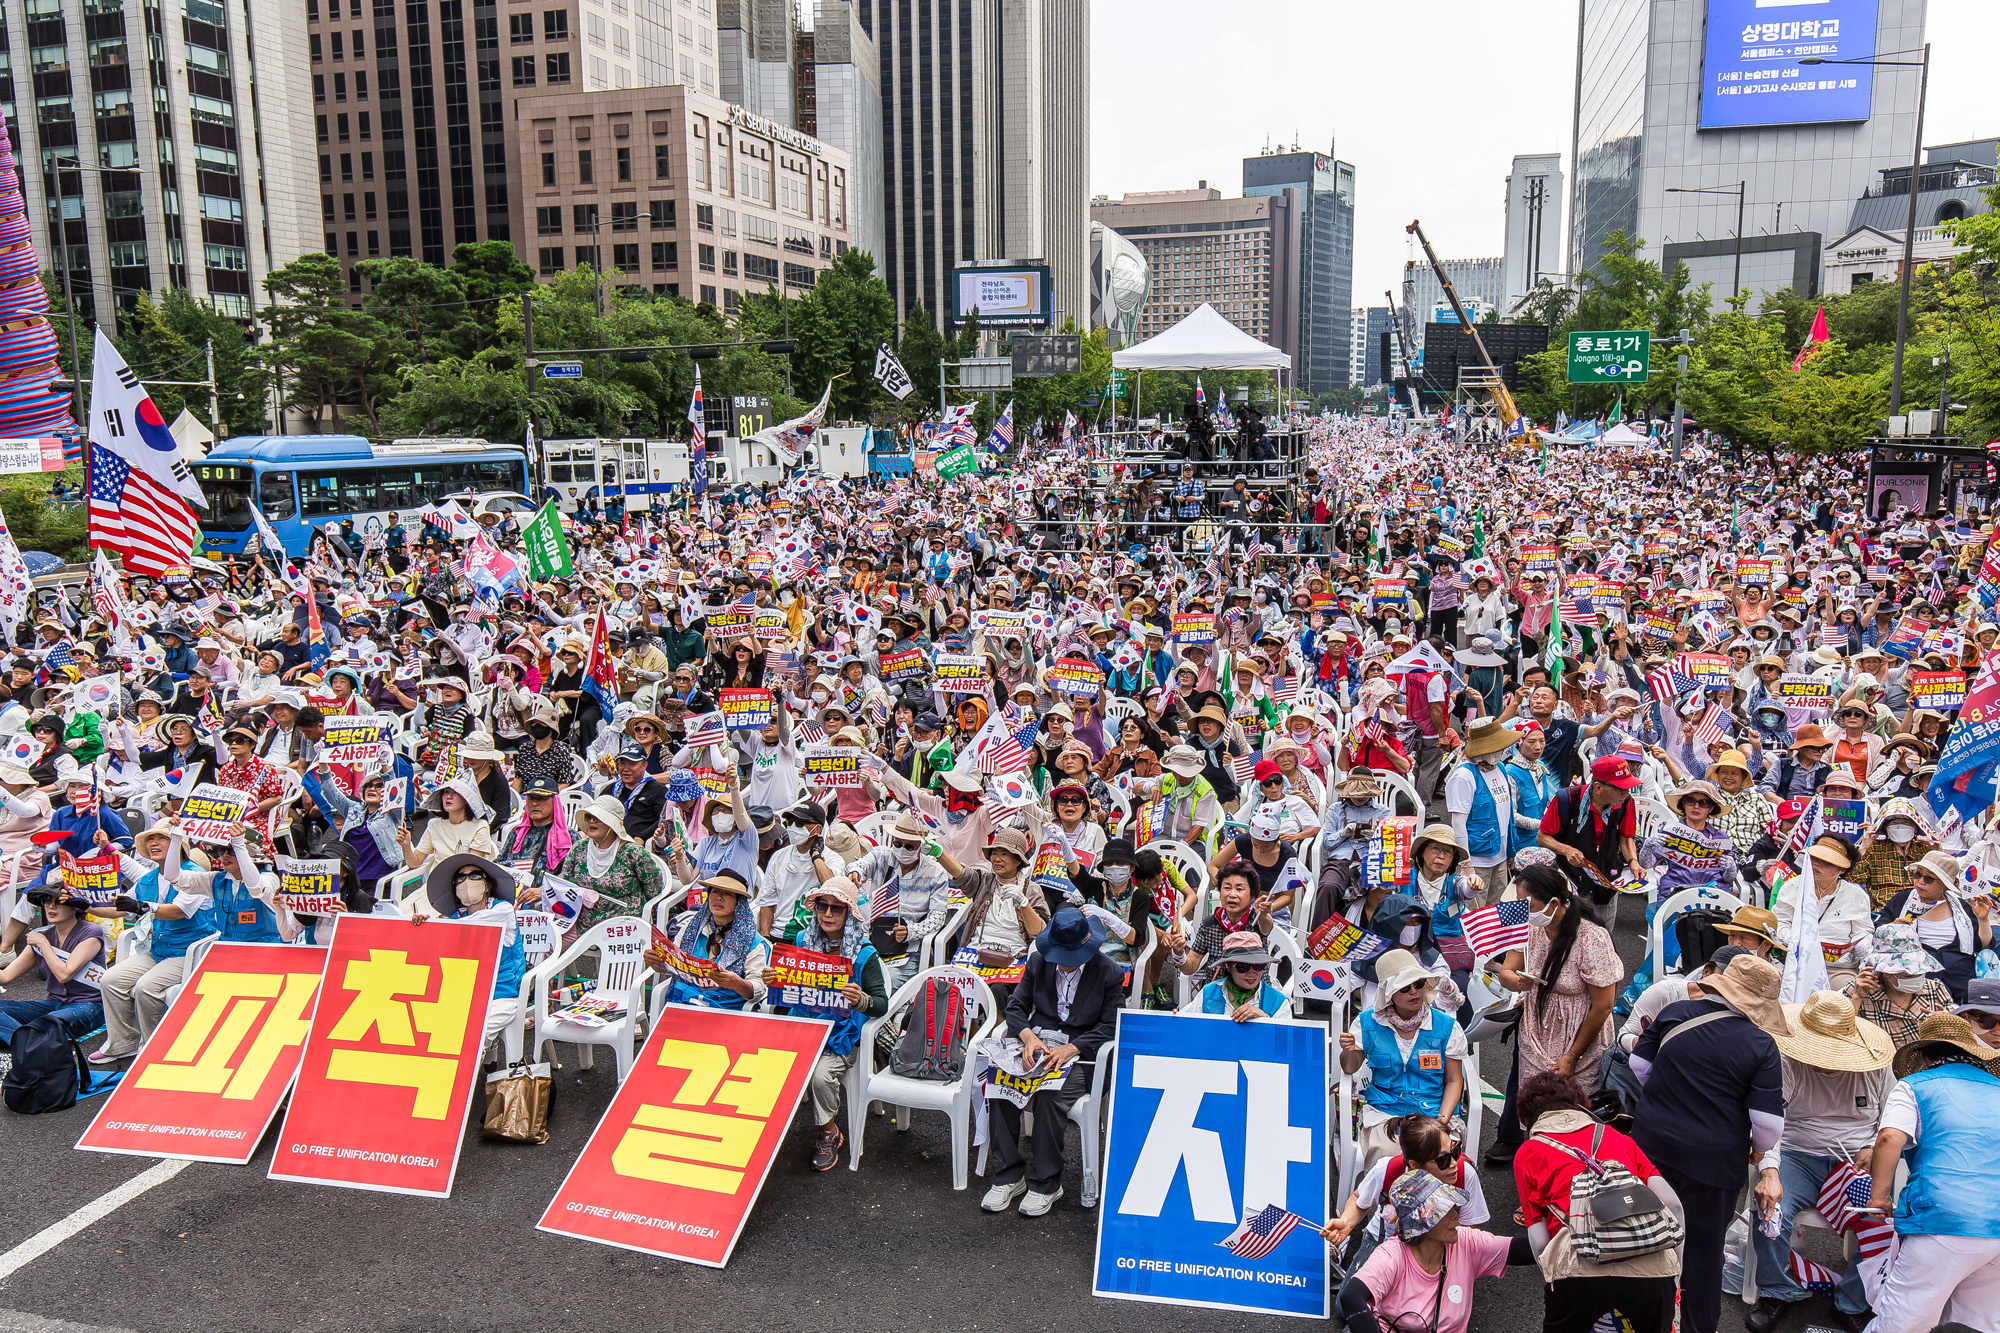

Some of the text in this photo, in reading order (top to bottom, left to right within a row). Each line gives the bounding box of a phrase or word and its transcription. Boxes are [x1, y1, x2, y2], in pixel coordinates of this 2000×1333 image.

[1741, 19, 1840, 43] 상명대학교
[1741, 44, 1838, 58] 서울캠퍼스 천안캠퍼스
[1717, 68, 1799, 82] [서울] 논술전형 신설
[1717, 85, 1741, 96] [서울]
[1743, 83, 1778, 94] 실기고사
[1780, 82, 1816, 92] 수시모집
[1838, 79, 1857, 88] 시행
[745, 112, 824, 156] SEOUL FINANCE CENTER
[1575, 336, 1641, 352] 종로1가
[1574, 353, 1625, 365] Jongno 1(il)-ga
[1610, 366, 1616, 375] 6
[734, 396, 746, 408] 현재
[747, 396, 757, 408] 소음
[202, 467, 235, 480] 501
[1875, 478, 1926, 487] DUALSONIC
[539, 512, 563, 571] 자유마을
[707, 614, 748, 627] 부정선거
[987, 616, 1022, 627] 부정선거
[1175, 622, 1214, 633] 주사파척결
[1646, 620, 1675, 632] 사파척결
[1180, 631, 1214, 642] 끝장내자
[883, 657, 924, 674] 주사파척결
[937, 664, 980, 679] 부정선거
[1056, 669, 1101, 684] 주사파척결
[940, 679, 985, 692] 수사하라
[1057, 679, 1100, 694] 끝장내자
[1782, 683, 1828, 696] 부정선거
[1912, 682, 1966, 695] 주사파척결
[737, 693, 749, 701] 5.16
[722, 700, 771, 714] 주사파척결
[727, 712, 771, 727] 끝장내자
[325, 727, 380, 745] 부정선거
[808, 757, 856, 772] 부정선거
[184, 798, 243, 821] 부정선거
[1837, 808, 1858, 819] 서버
[1381, 817, 1396, 882] 주사파척결
[1395, 833, 1405, 851] 5.16
[1667, 834, 1725, 858] 부정선거
[281, 873, 333, 893] 부정선거
[517, 916, 548, 928] 금봉사자
[608, 942, 644, 955] 자리입니
[777, 956, 846, 973] 4.19, 5.16 혁명으로
[774, 966, 850, 990] 주사파척결
[782, 984, 851, 1009] 끝장내자
[134, 971, 322, 1100] 파
[326, 949, 480, 1121] 척
[1423, 1056, 1438, 1066] 헌금
[611, 1038, 799, 1195] 결
[106, 1120, 247, 1140] GO FREE UNIFICATION KOREA!
[1117, 1054, 1312, 1225] 자
[292, 1143, 439, 1168] GO FREE UNIFICATION KOREA!
[566, 1201, 720, 1239] GO FREE UNIFICATION KOREA!
[1116, 1257, 1307, 1288] GO FREE UNIFICATION KOREA!
